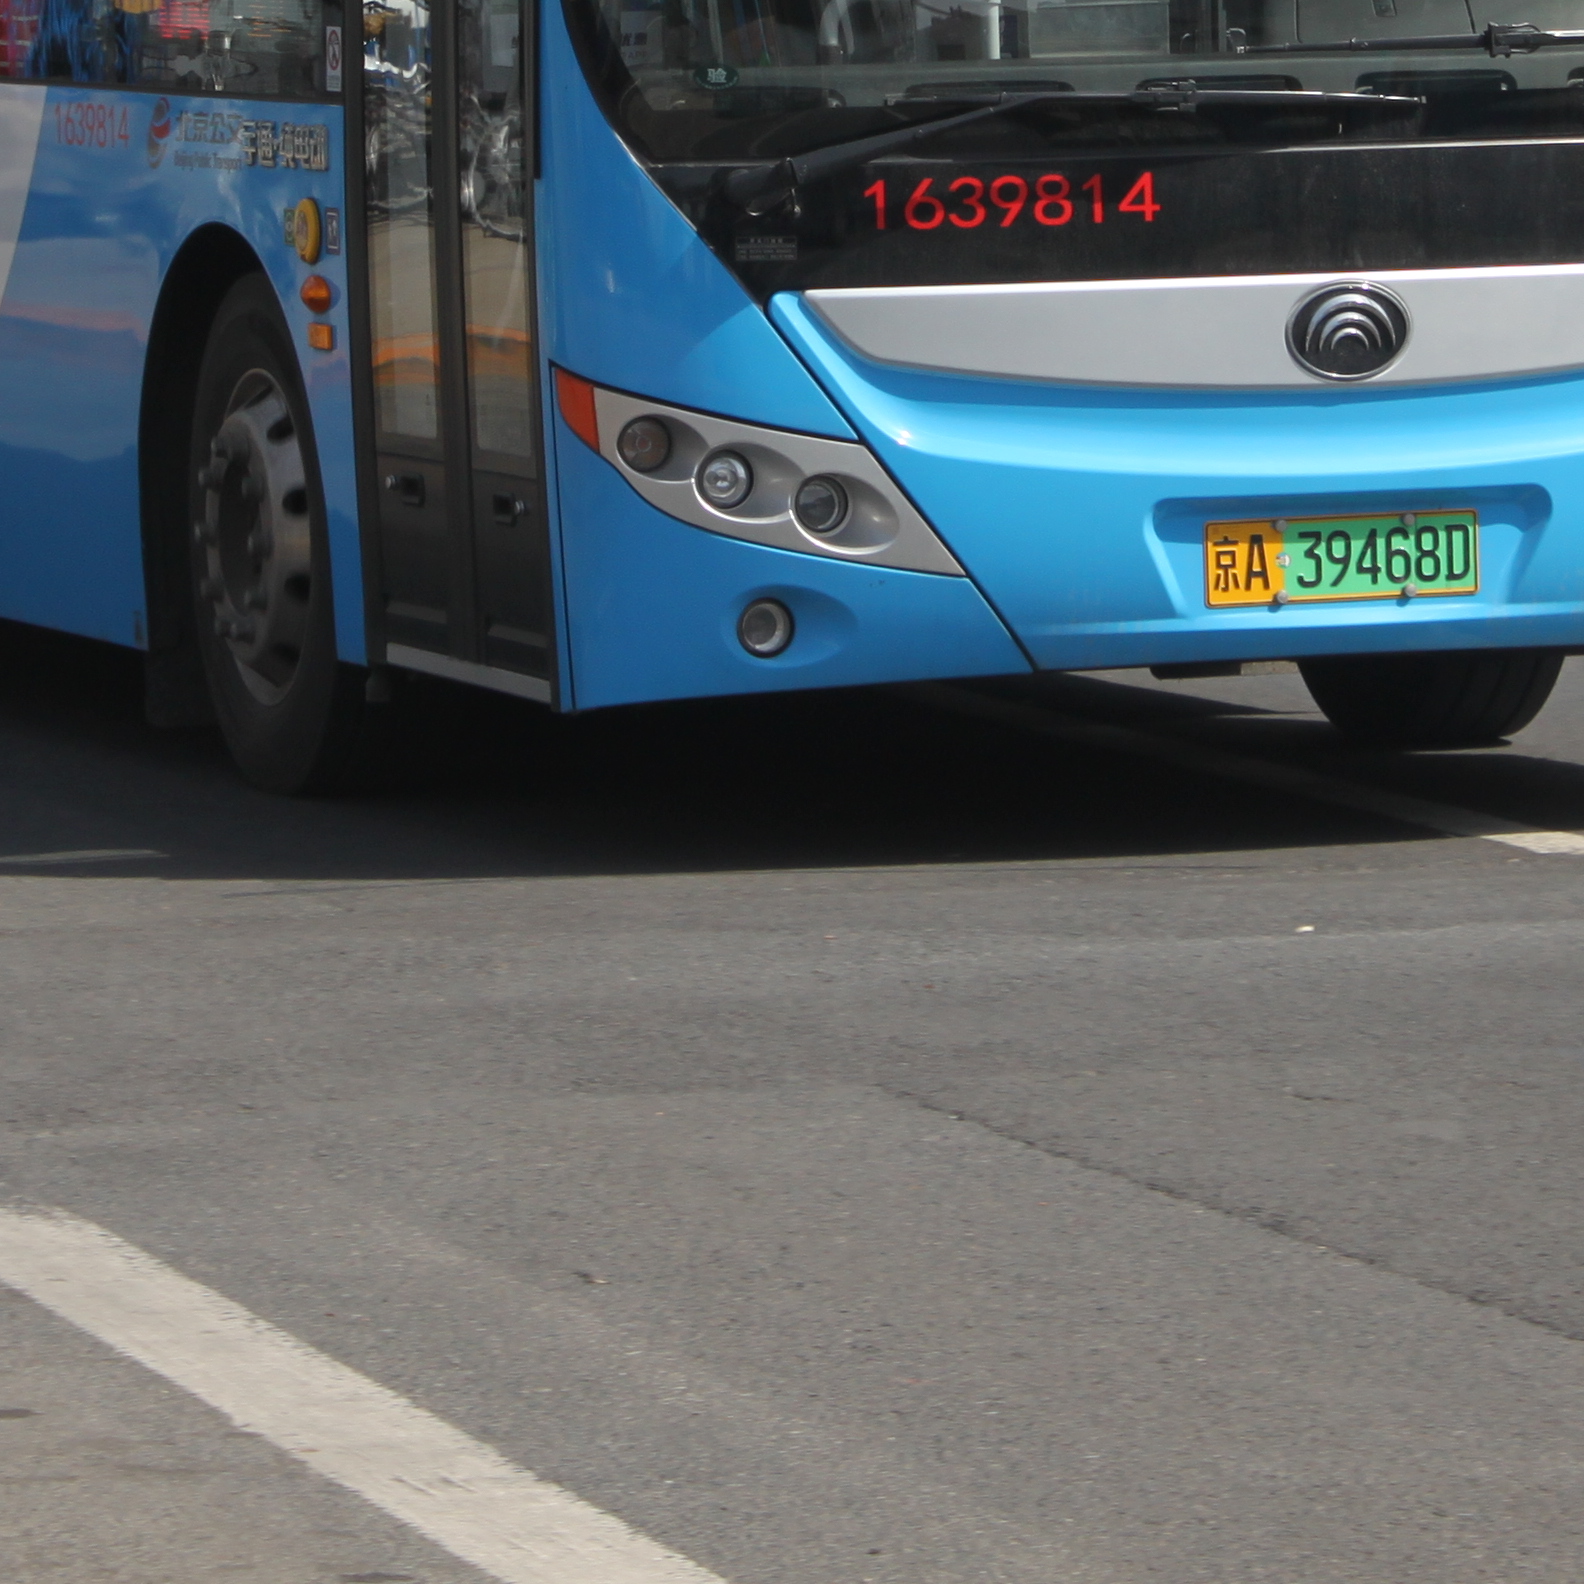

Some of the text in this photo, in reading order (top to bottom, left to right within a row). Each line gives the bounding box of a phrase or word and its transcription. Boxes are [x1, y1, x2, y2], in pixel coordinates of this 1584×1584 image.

[706, 67, 728, 84] 验
[54, 101, 130, 148] 1639814
[863, 171, 1161, 230] 1639814
